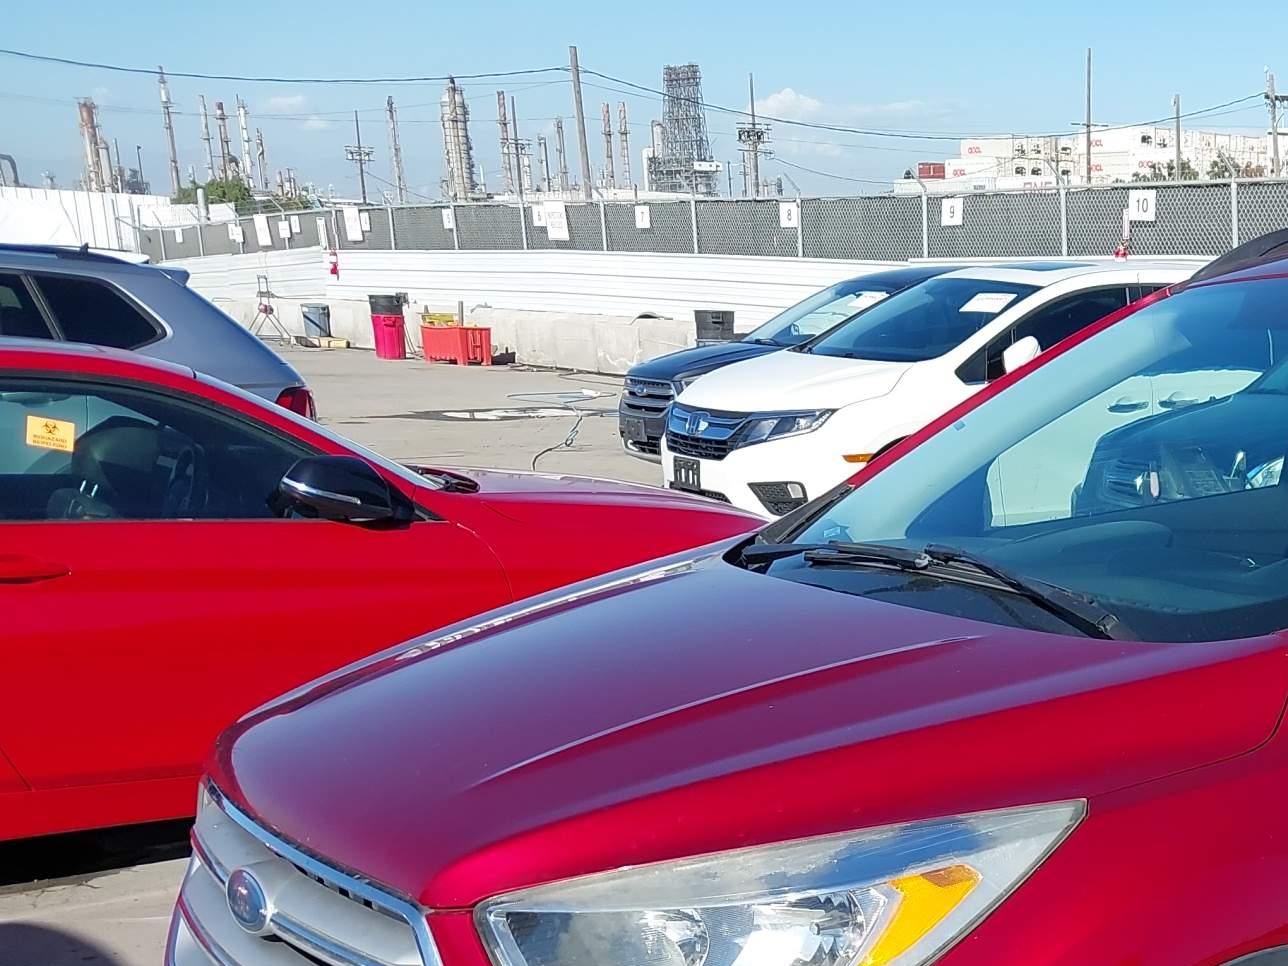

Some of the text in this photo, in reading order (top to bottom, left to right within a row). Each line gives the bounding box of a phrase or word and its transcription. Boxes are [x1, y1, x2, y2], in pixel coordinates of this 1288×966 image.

[949, 205, 954, 218] 9
[1136, 198, 1148, 213] 10
[787, 208, 792, 222] 8
